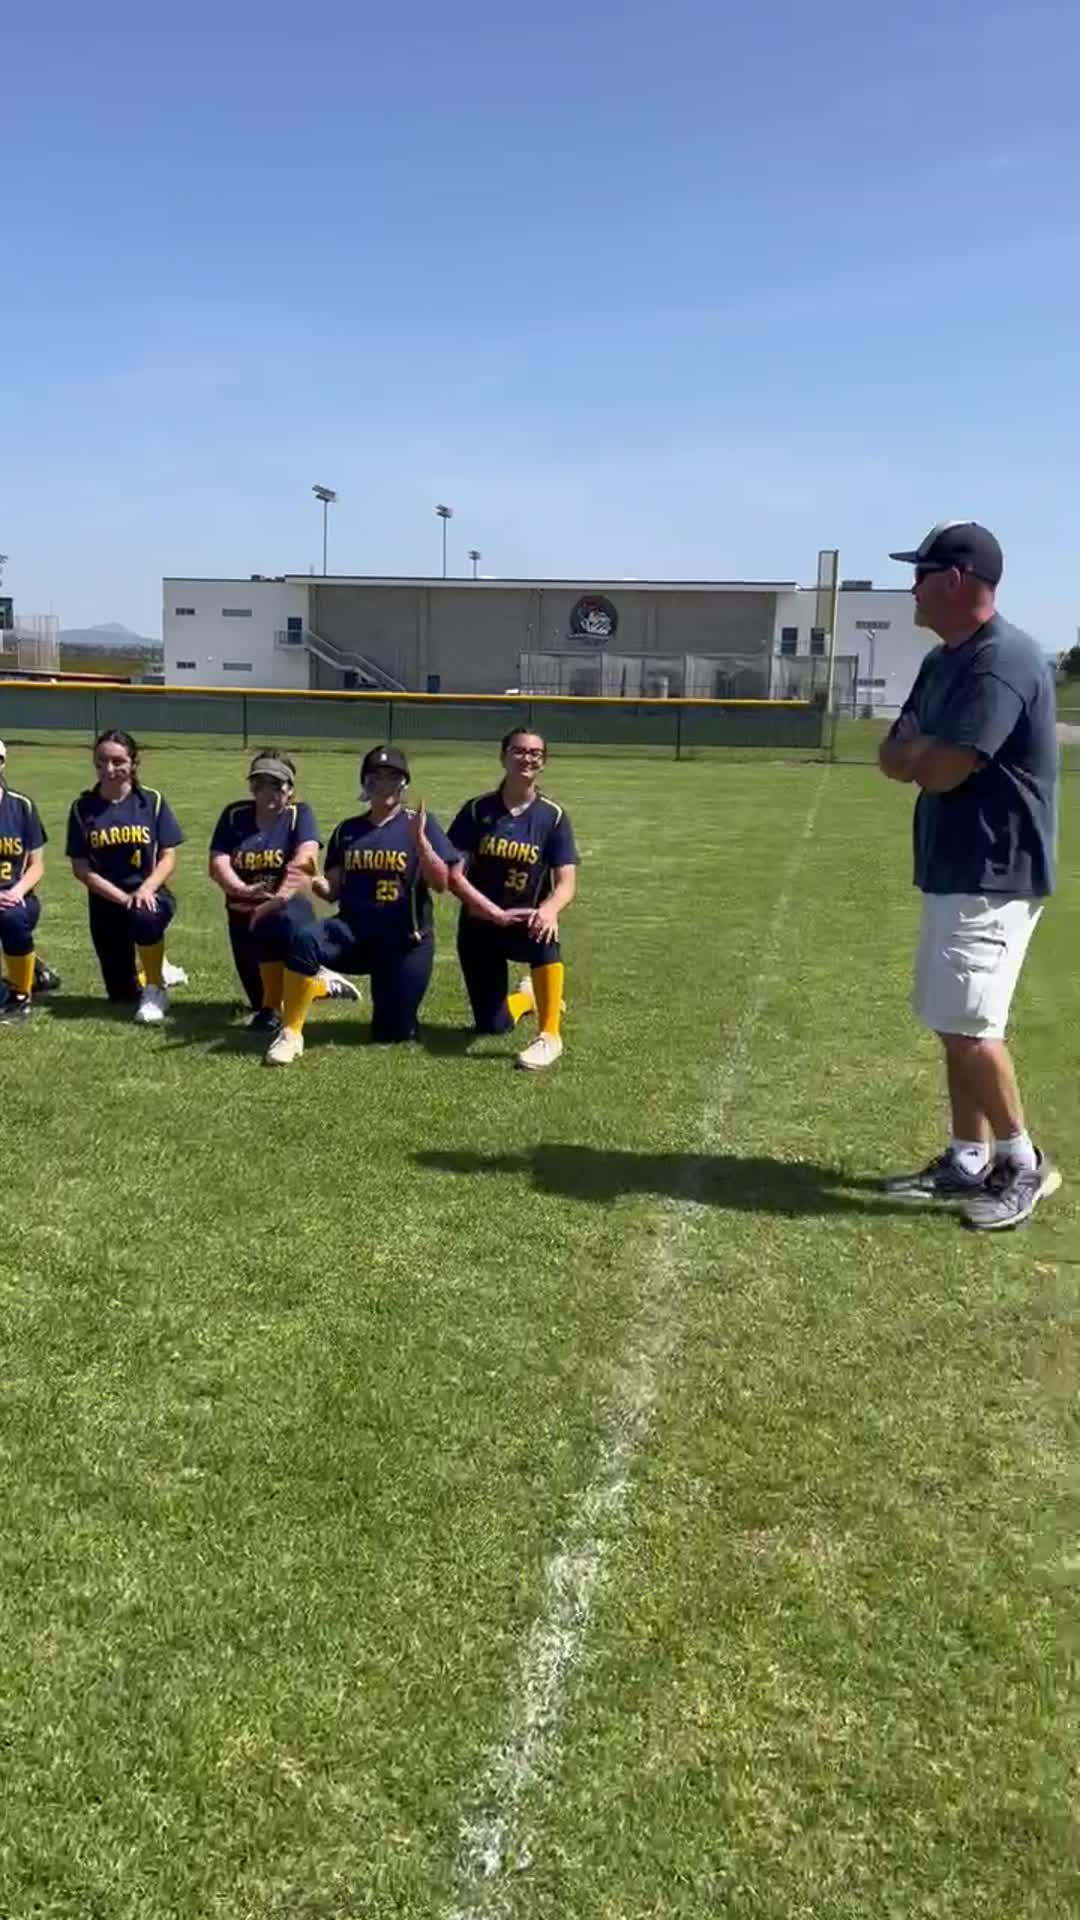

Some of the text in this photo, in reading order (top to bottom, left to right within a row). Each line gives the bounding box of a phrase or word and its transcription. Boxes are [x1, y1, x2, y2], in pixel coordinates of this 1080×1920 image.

[90, 825, 151, 848] BARONS
[130, 849, 142, 869] 4
[233, 849, 284, 870] ARONS
[344, 849, 408, 872] BARONS
[375, 880, 400, 901] 25
[504, 870, 529, 891] 33
